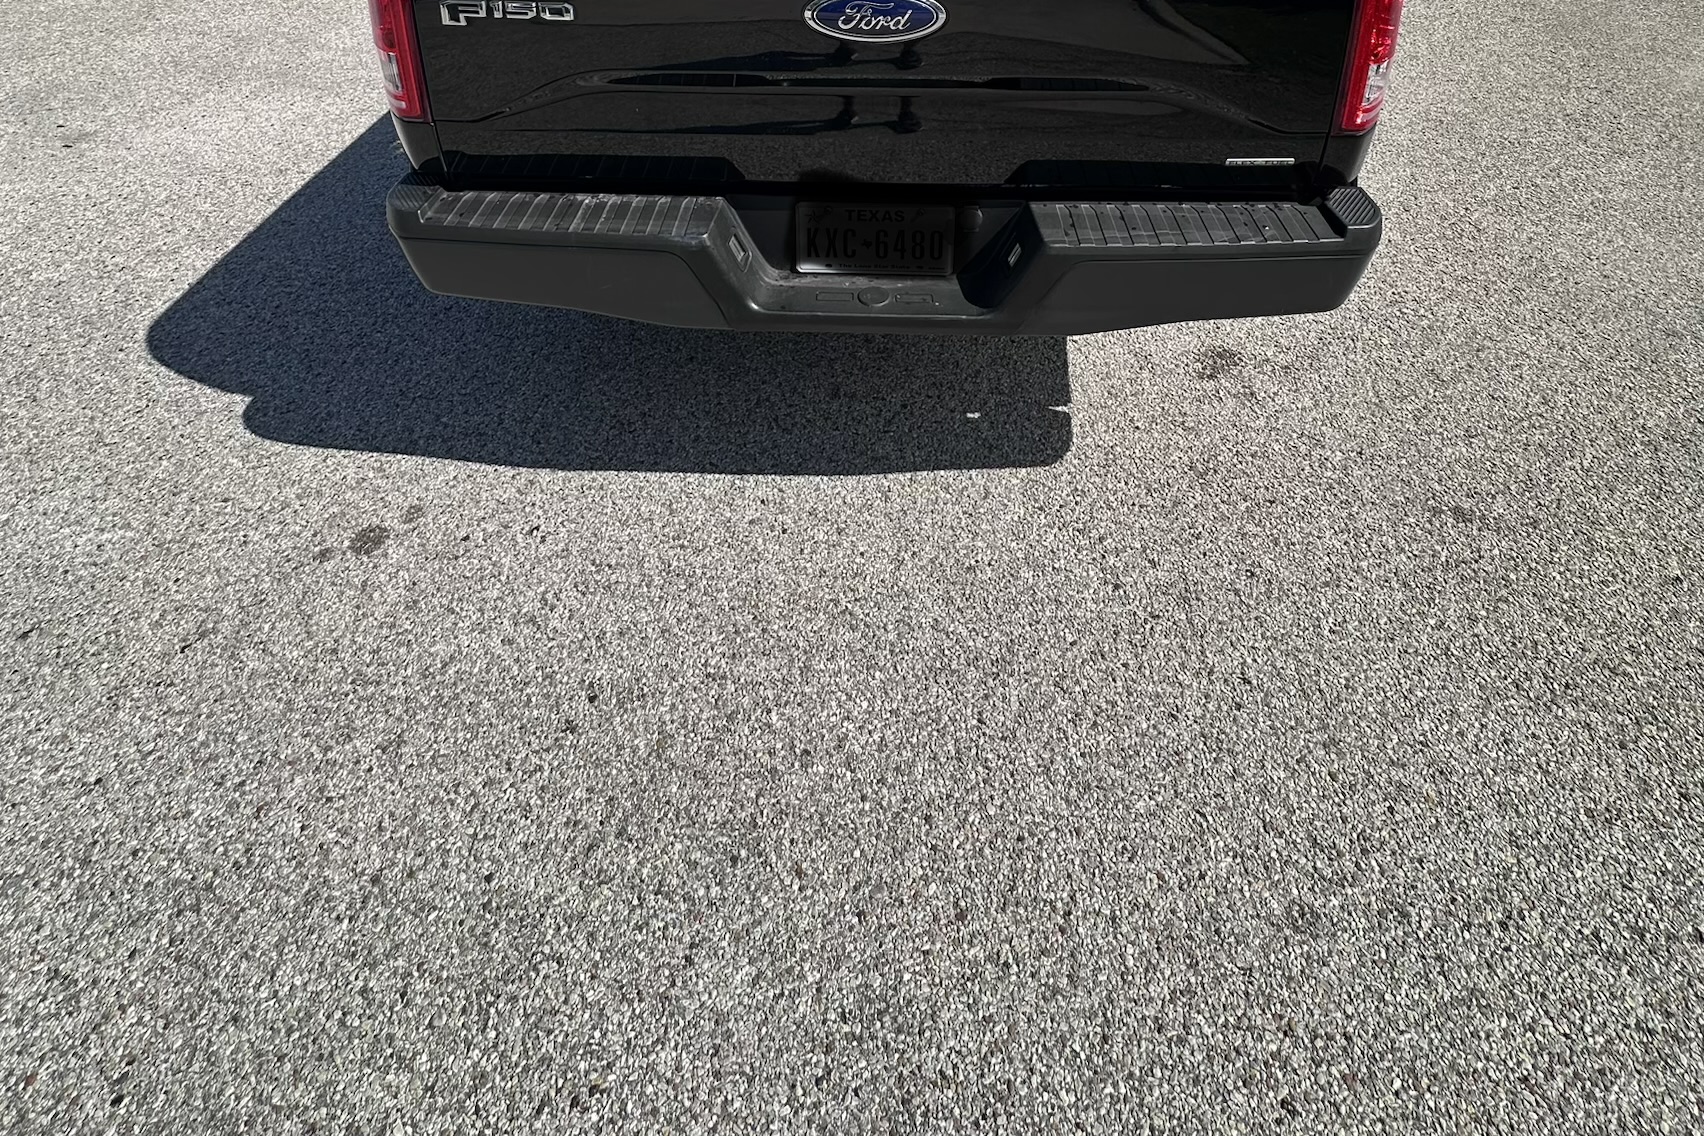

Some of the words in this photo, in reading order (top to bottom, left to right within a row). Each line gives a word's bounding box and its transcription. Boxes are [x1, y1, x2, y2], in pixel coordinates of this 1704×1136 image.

[440, 0, 575, 26] F150
[838, 0, 912, 31] Ford
[845, 208, 905, 223] TEXAS
